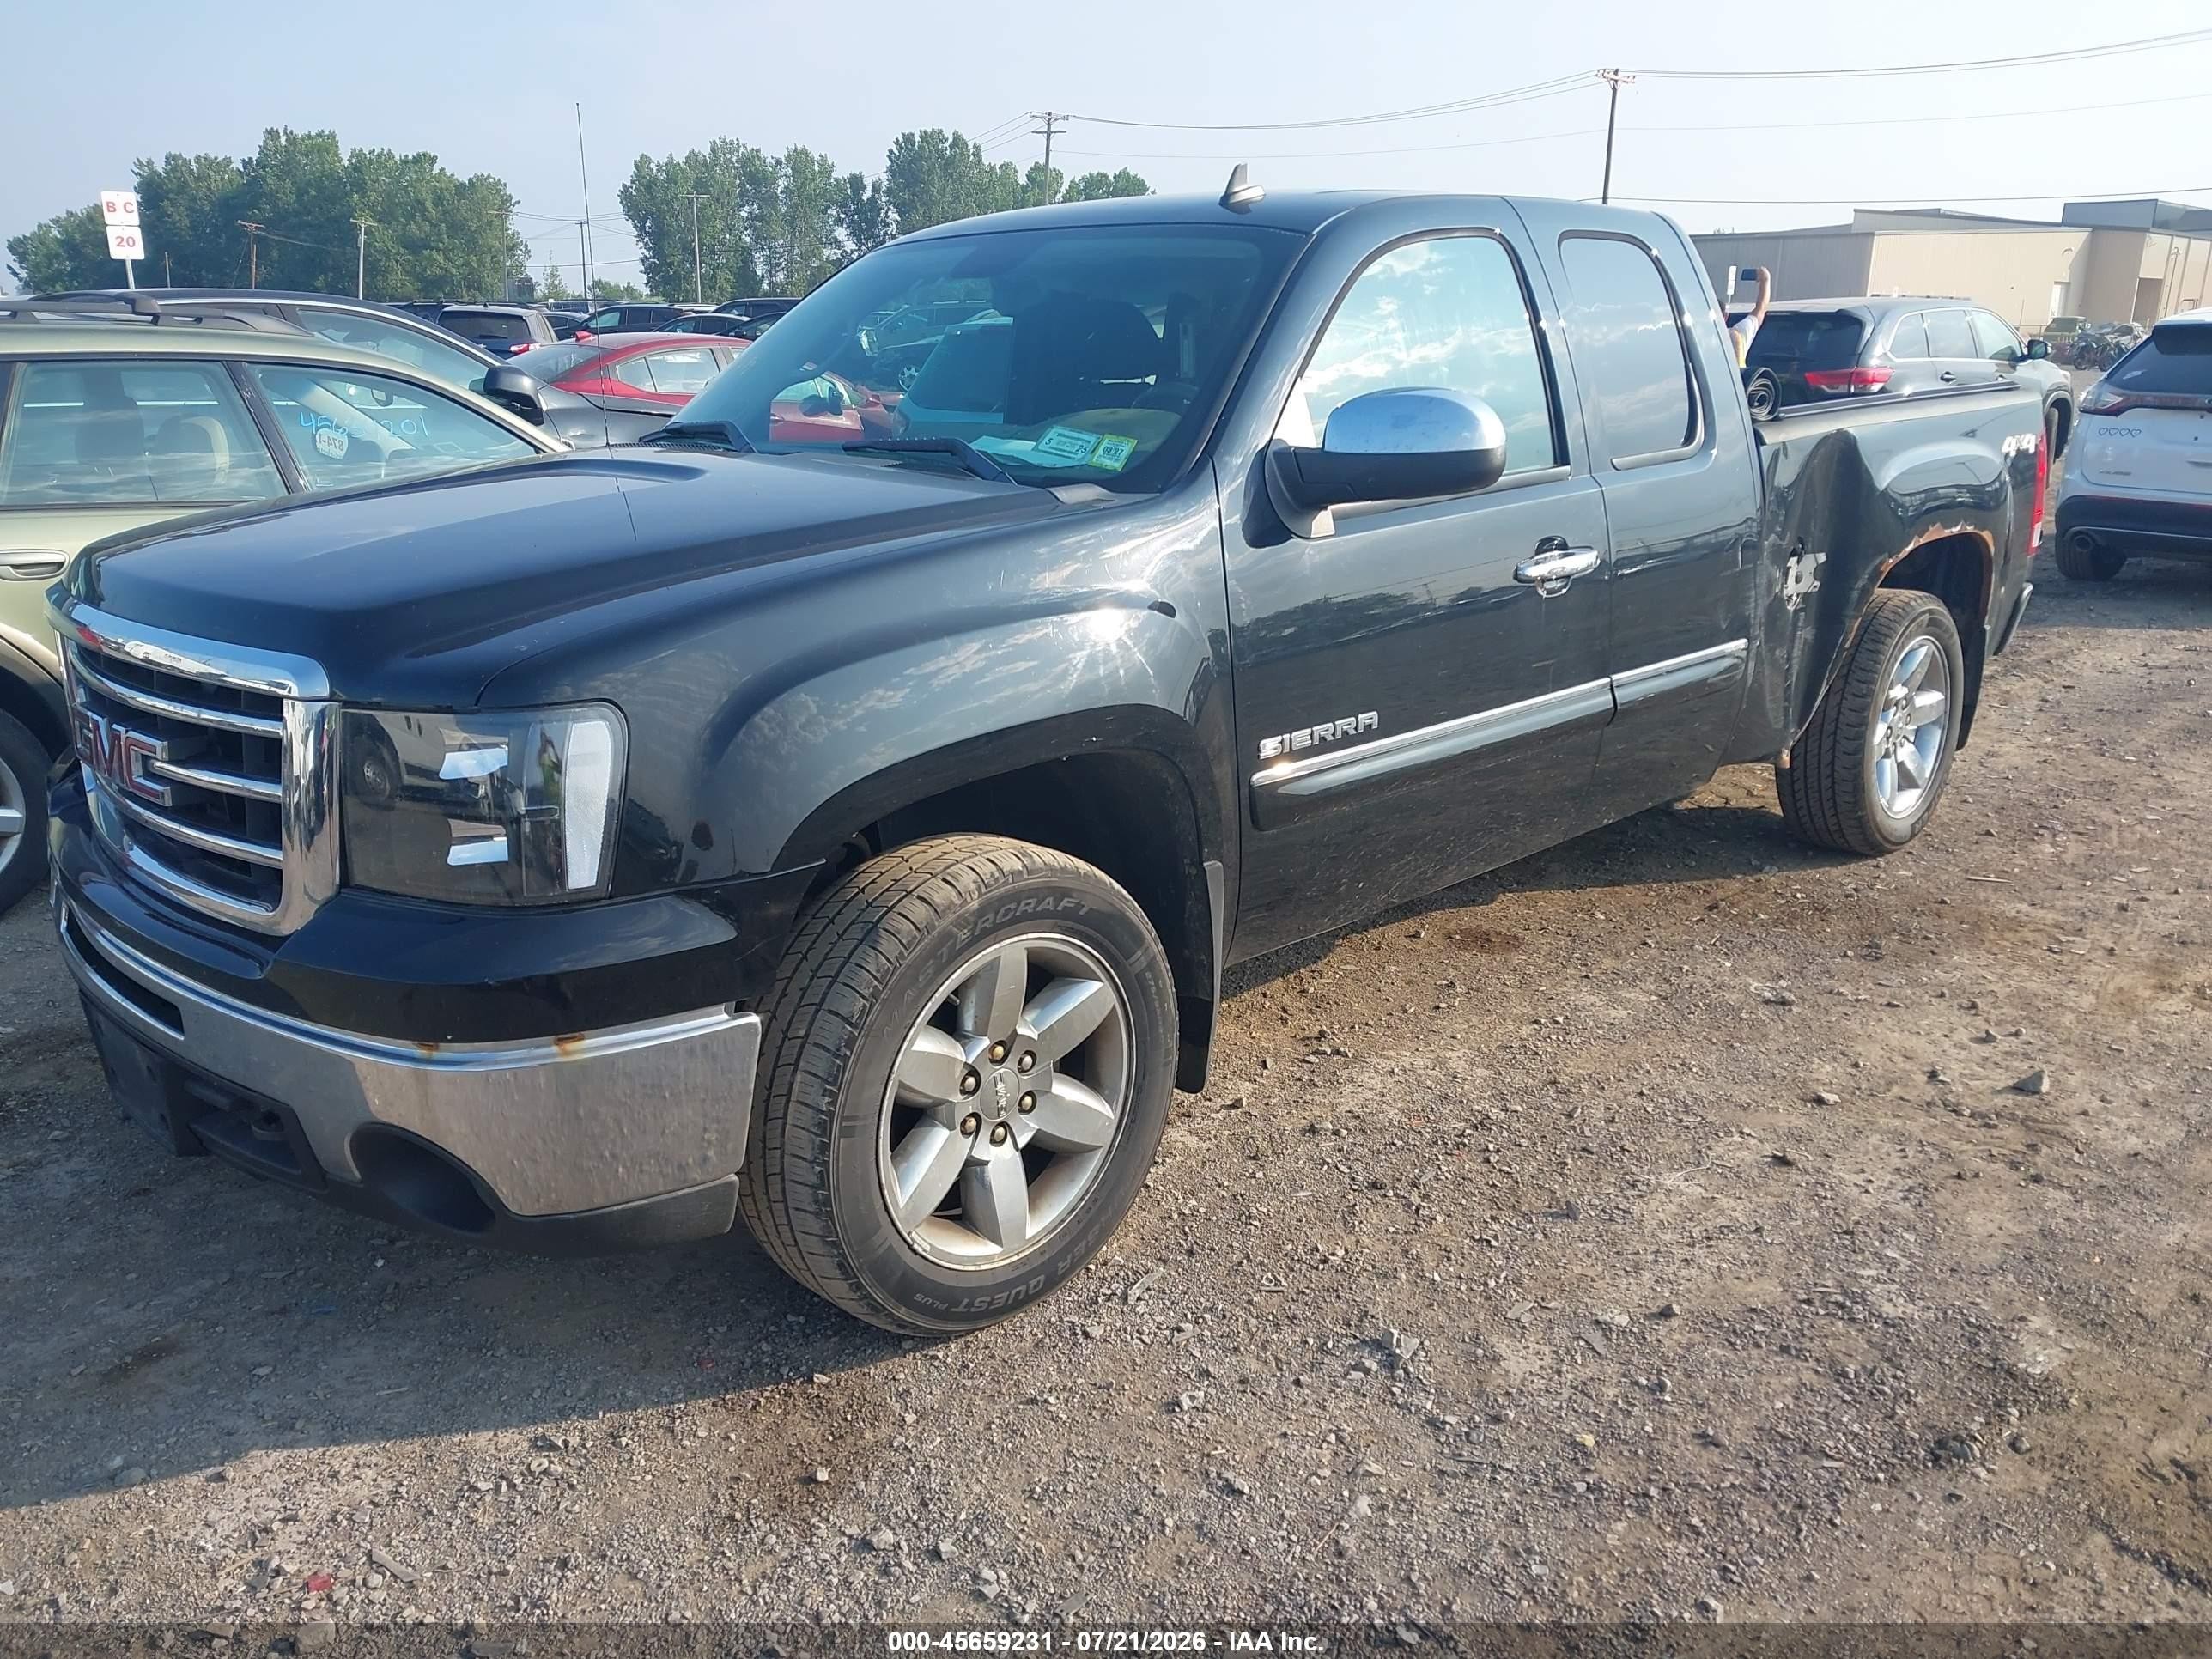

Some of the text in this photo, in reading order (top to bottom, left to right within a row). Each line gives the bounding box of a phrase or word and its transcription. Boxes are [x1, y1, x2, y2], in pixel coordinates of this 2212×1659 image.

[106, 201, 135, 214] B C
[115, 235, 136, 248] 20
[1075, 445, 1090, 453] 25
[1259, 710, 1379, 760] SIERRA
[71, 704, 172, 807] GMC
[913, 1292, 950, 1310] PLUS
[951, 1273, 1046, 1313] QUEST
